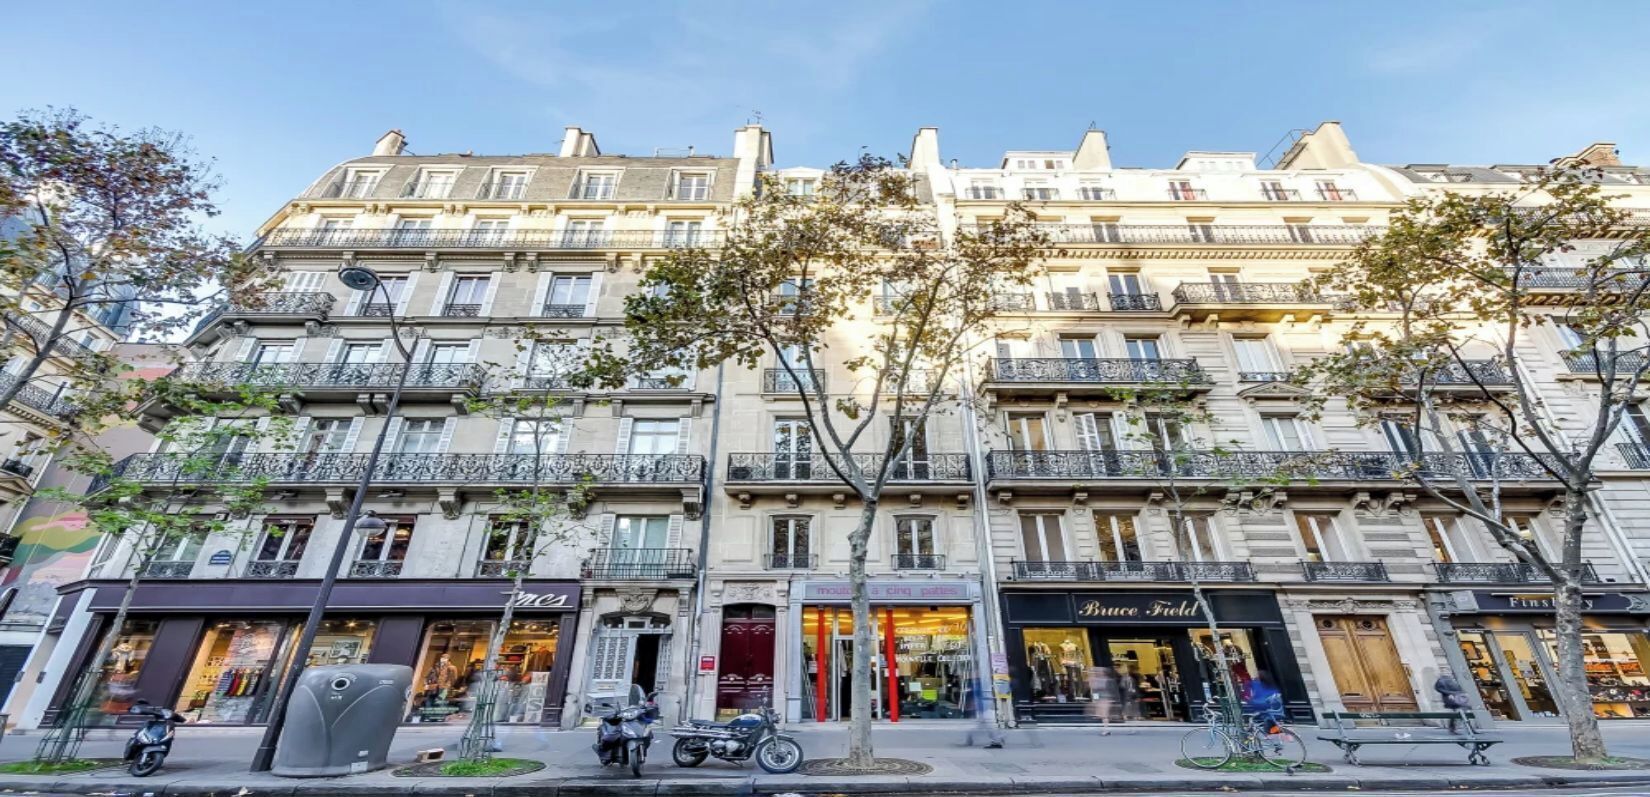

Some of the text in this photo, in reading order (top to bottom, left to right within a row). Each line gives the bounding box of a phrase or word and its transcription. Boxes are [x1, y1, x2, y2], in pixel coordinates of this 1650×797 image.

[886, 584, 912, 598] cinq
[920, 585, 958, 598] pattes
[1079, 600, 1199, 617] Bruce Field
[1509, 597, 1593, 610] Finsy
